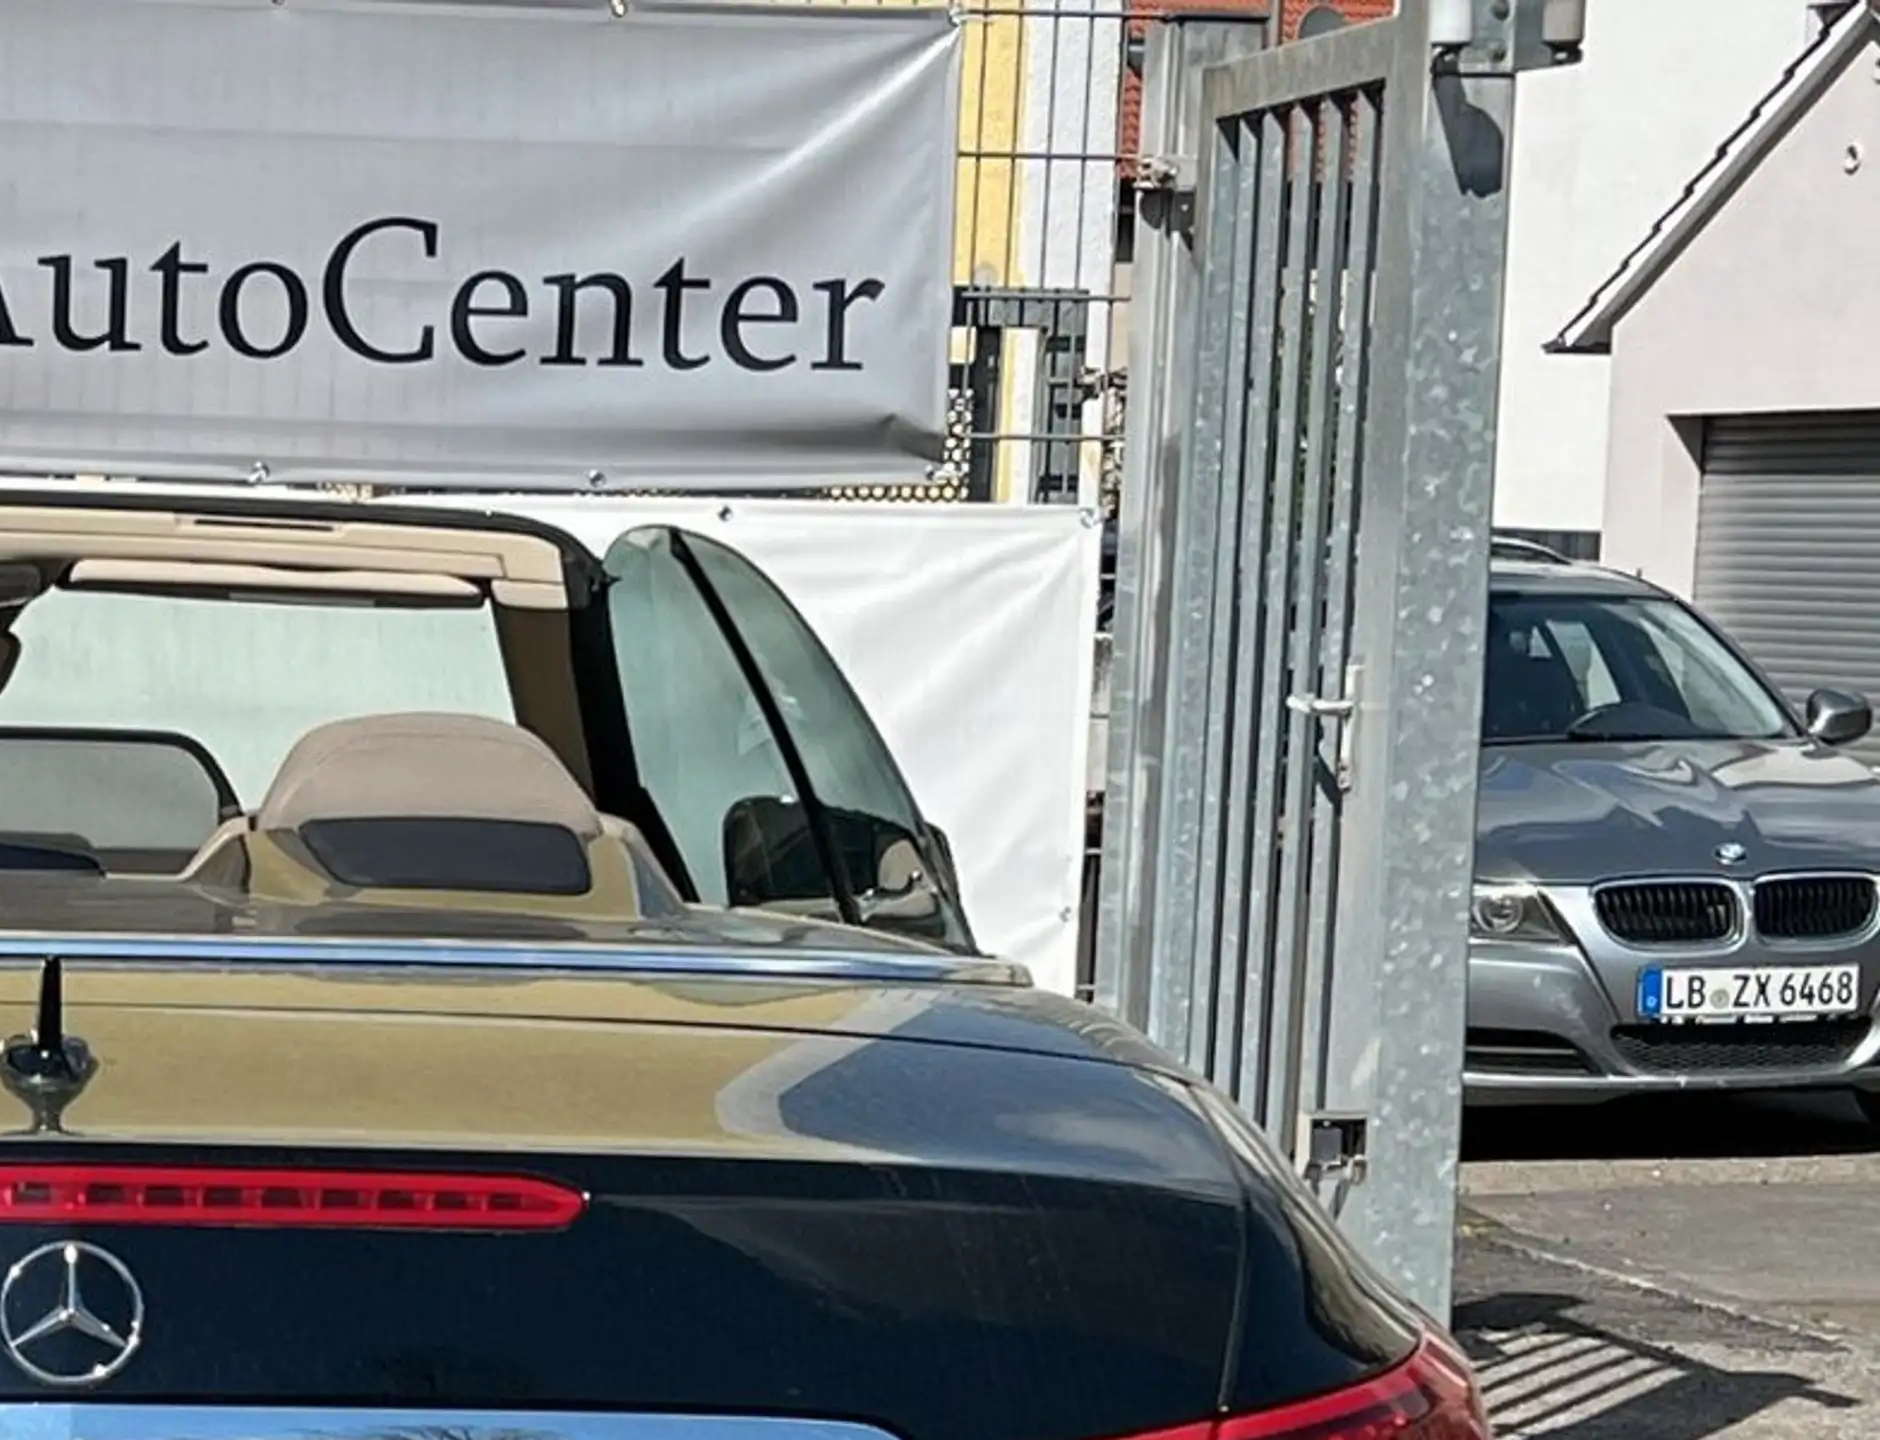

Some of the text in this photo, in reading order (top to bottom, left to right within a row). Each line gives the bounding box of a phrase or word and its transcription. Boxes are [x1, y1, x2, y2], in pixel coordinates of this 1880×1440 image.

[1666, 970, 1853, 1009] LB ZX 6468
